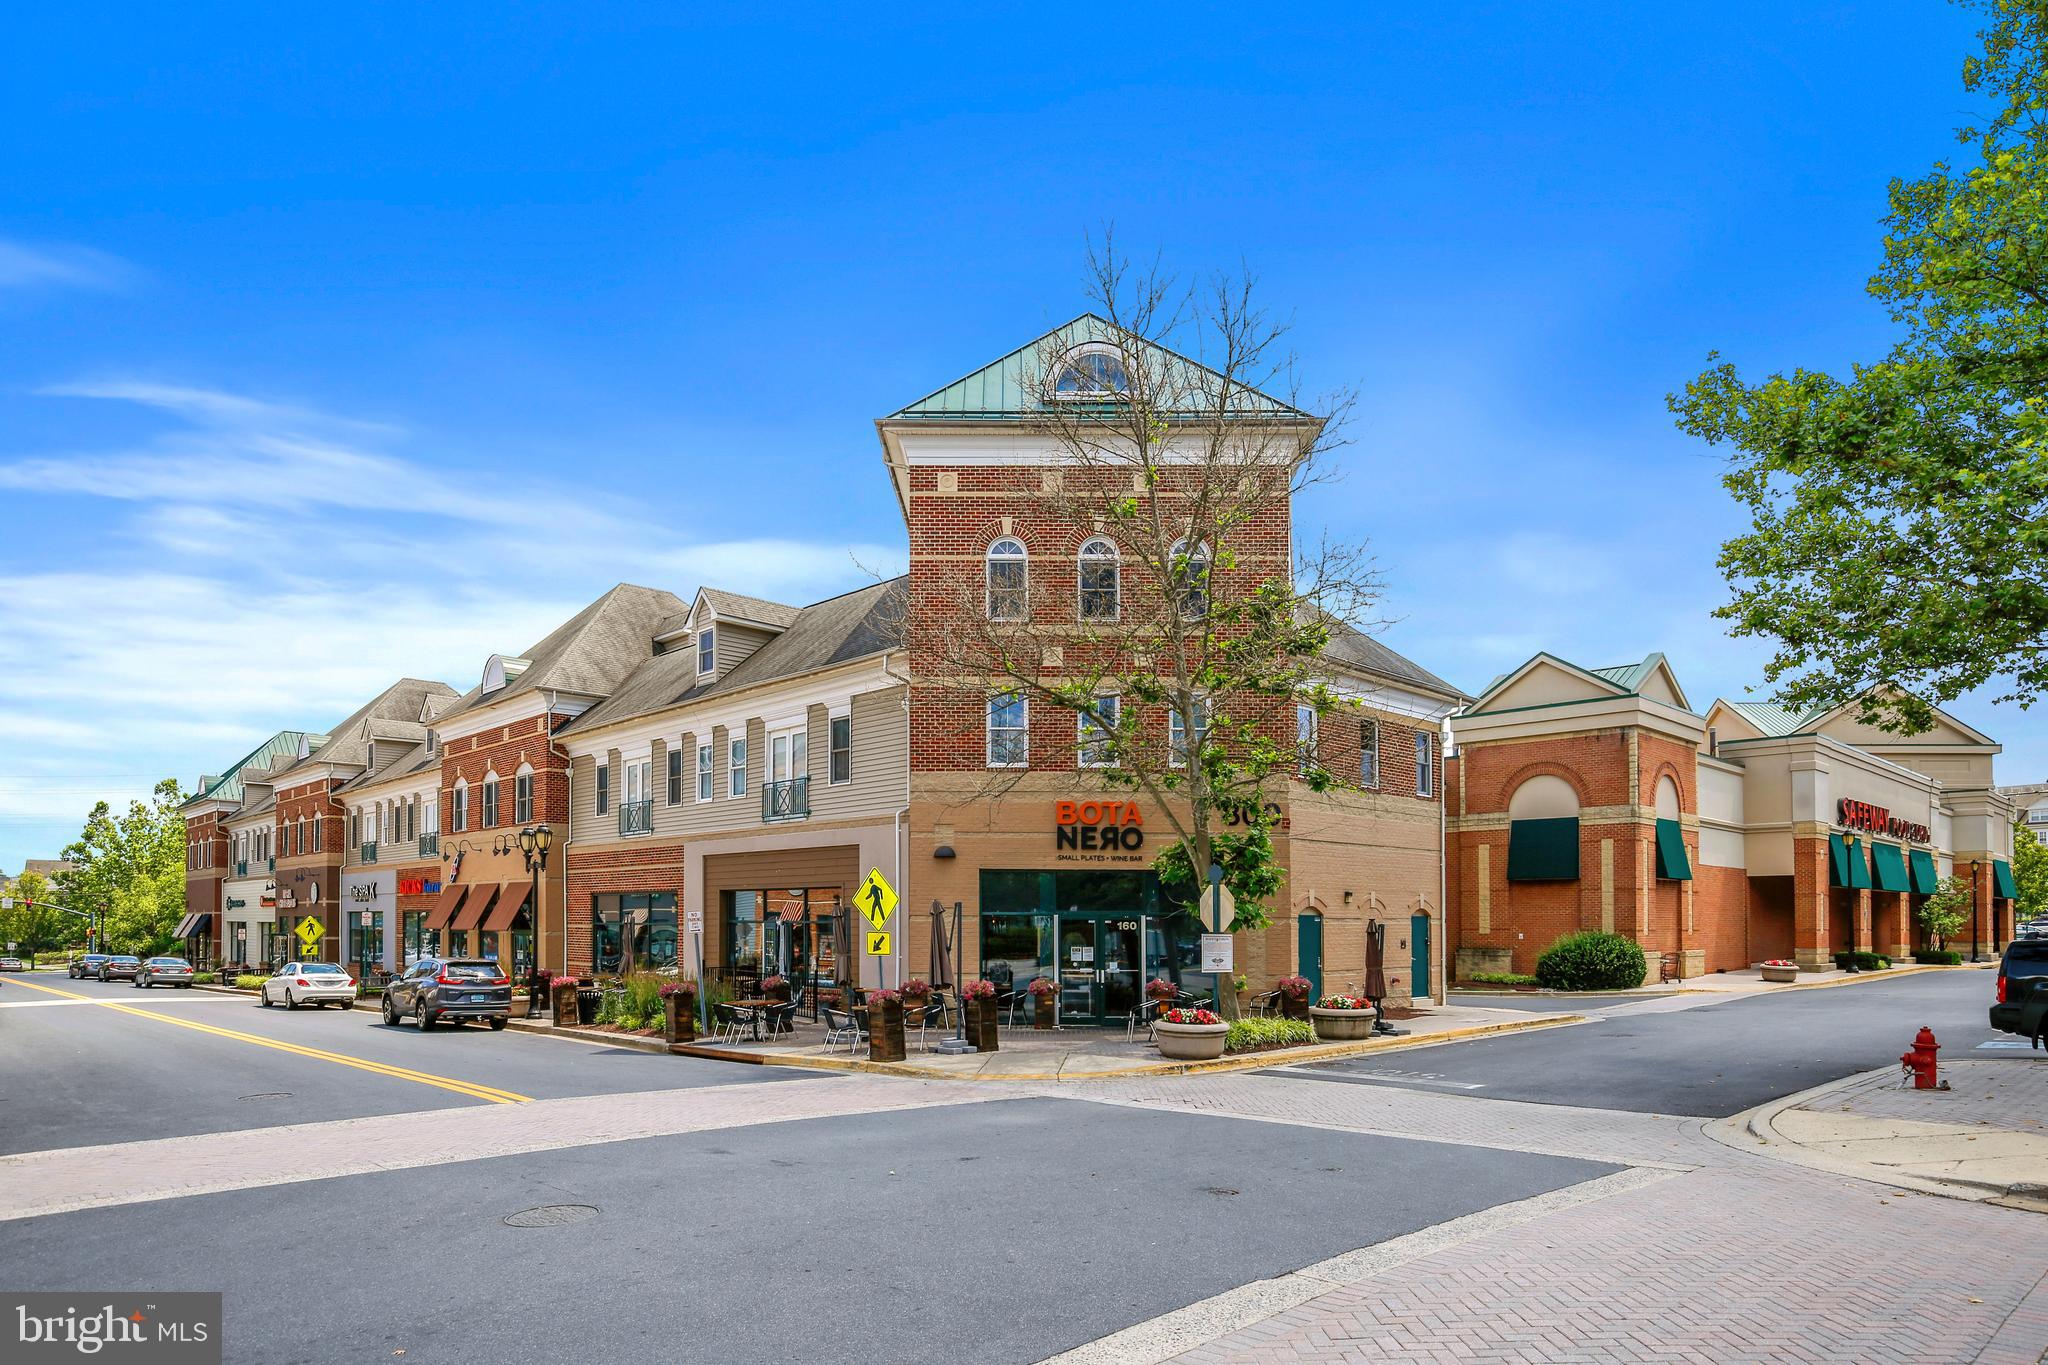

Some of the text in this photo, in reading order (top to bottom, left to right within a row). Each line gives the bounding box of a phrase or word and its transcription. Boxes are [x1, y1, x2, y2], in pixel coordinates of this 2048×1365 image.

[1056, 800, 1143, 826] BOTA
[1837, 797, 1889, 832] SAFEWAY
[1081, 854, 1105, 862] PLATES
[1117, 921, 1137, 931] 160
